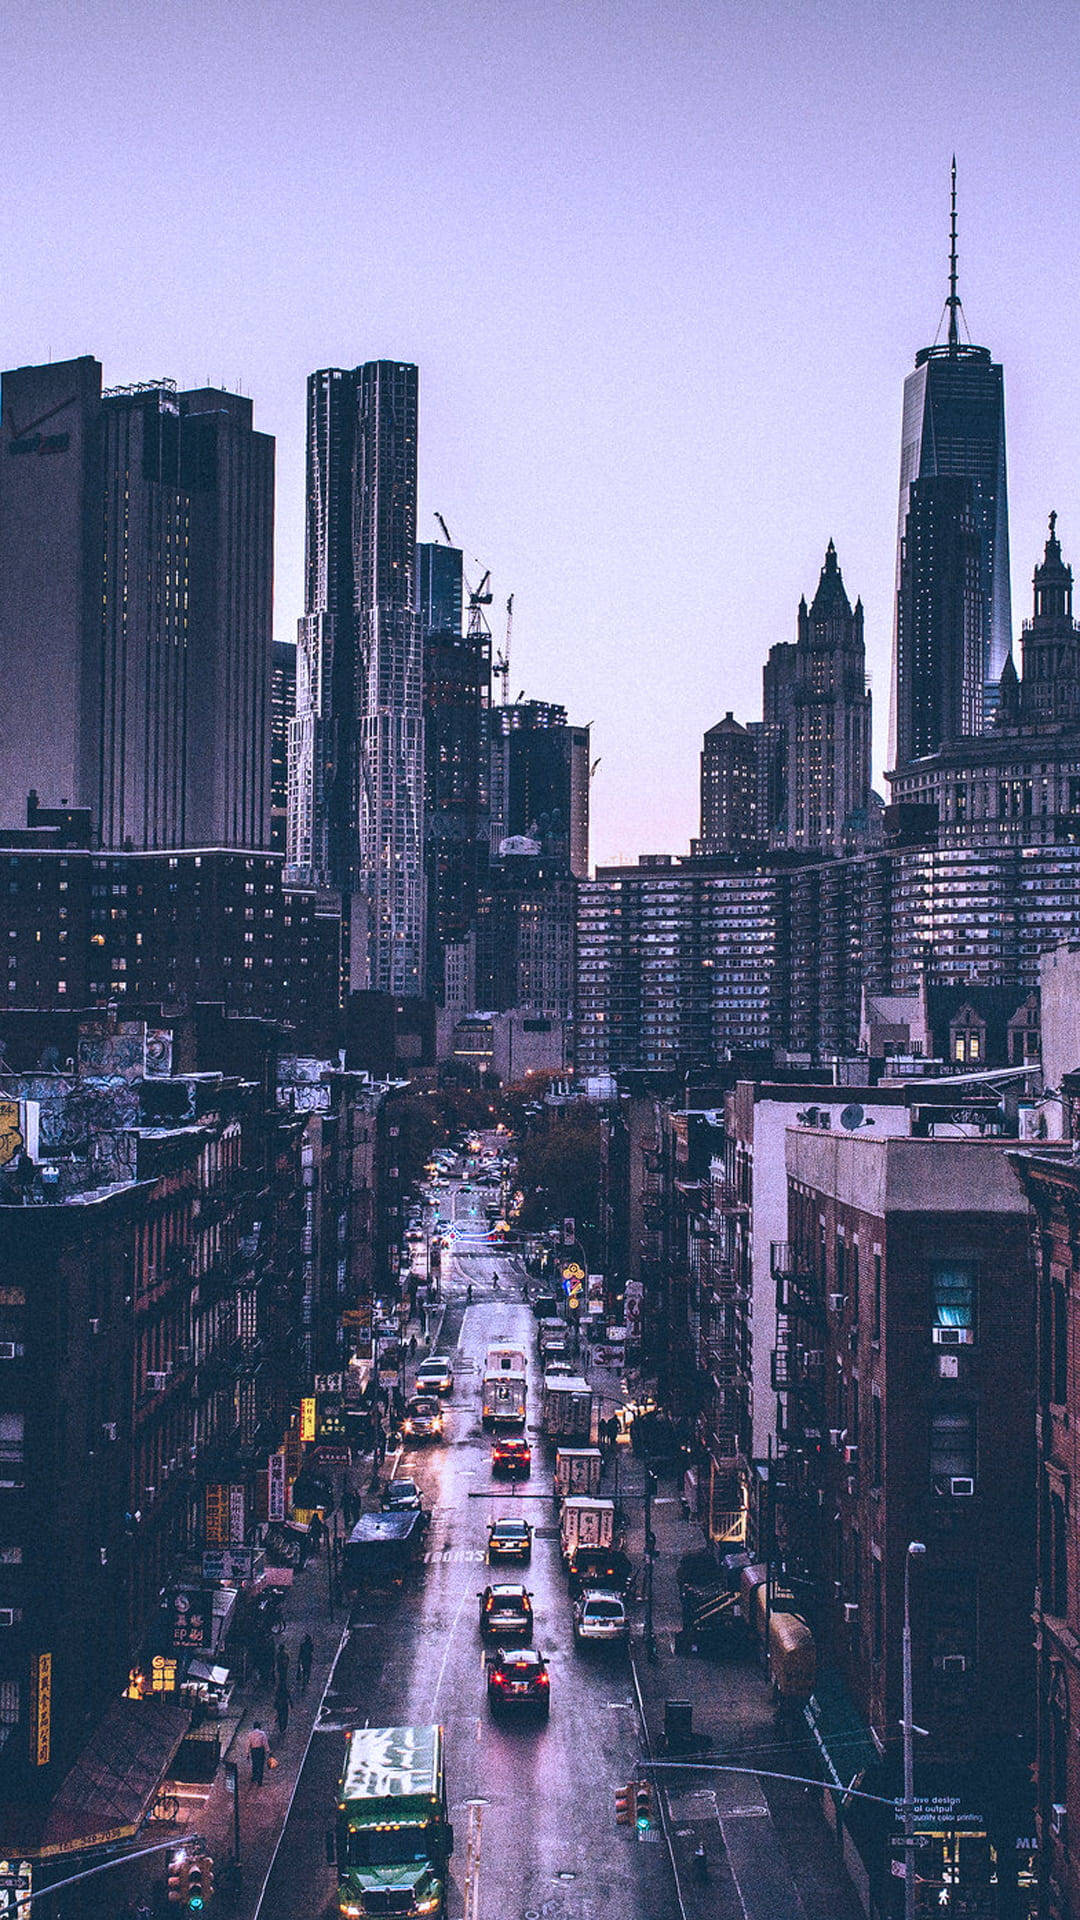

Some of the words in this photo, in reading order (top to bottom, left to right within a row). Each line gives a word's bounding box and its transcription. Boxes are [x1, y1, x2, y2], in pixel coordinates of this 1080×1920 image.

[931, 1796, 961, 1805] design
[924, 1804, 953, 1813] output
[936, 1813, 956, 1821] color
[956, 1813, 984, 1822] printing
